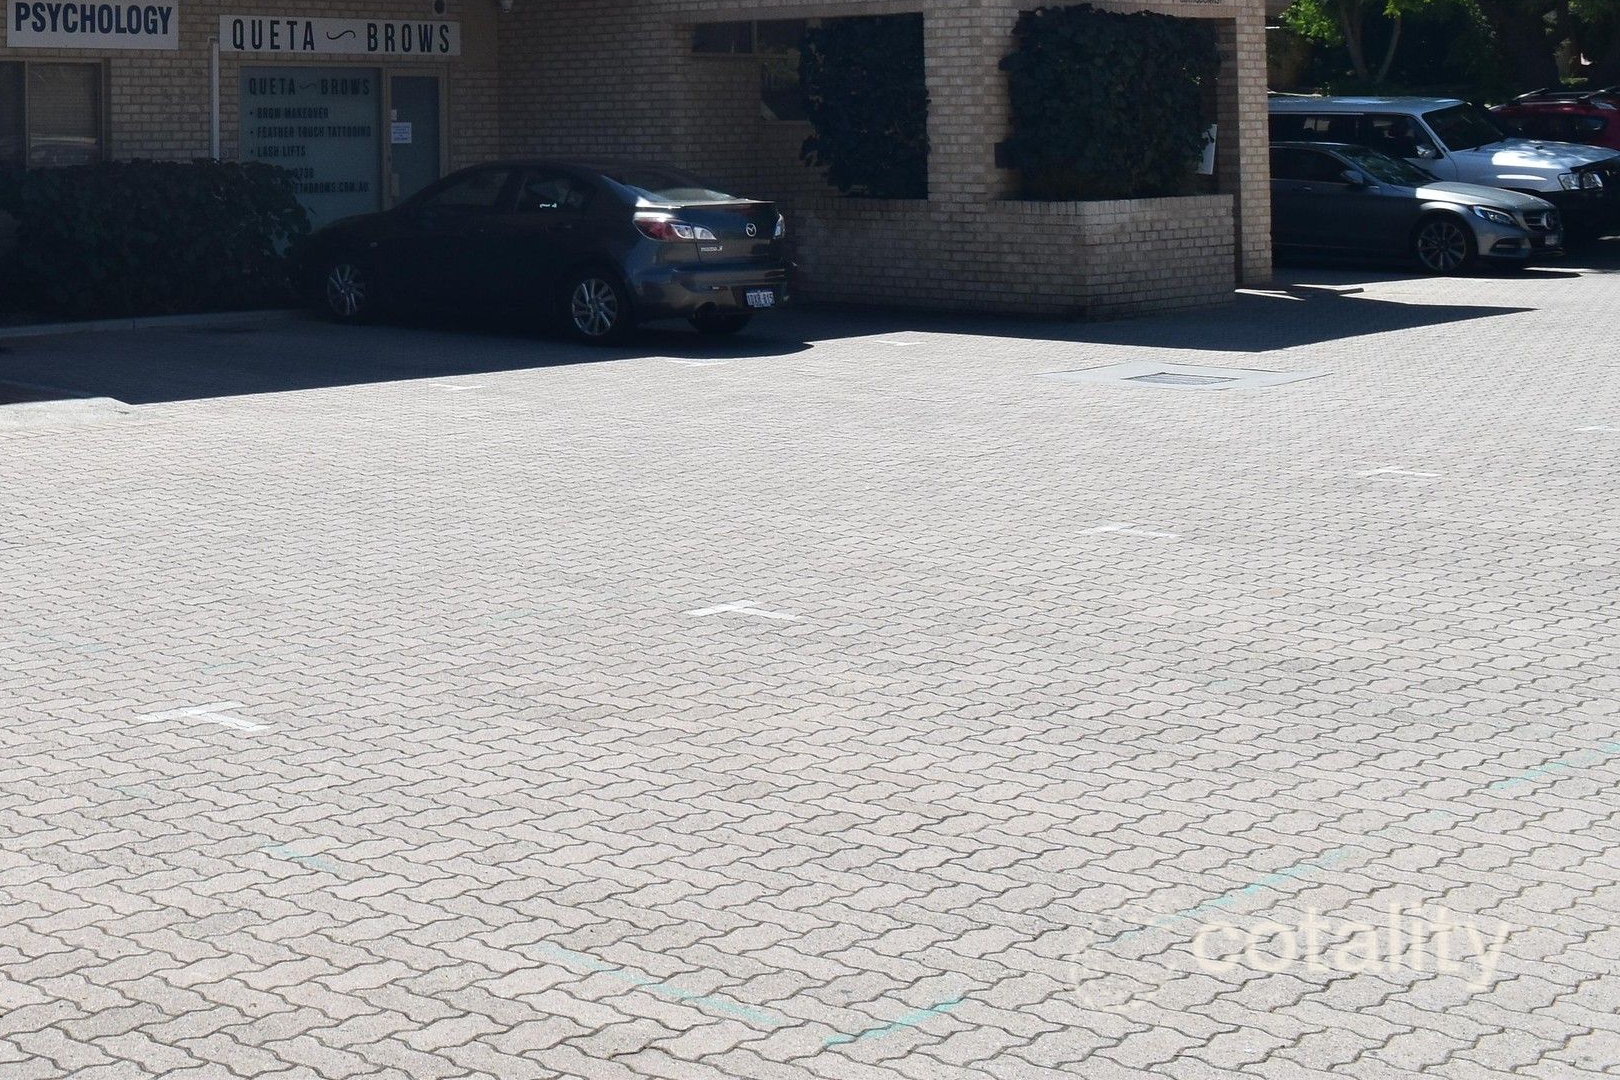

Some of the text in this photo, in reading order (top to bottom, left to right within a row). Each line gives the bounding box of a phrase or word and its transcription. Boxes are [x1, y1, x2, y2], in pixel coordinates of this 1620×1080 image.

[14, 1, 173, 36] PSYCHOLOGY
[232, 19, 450, 54] QUETA BROWS
[248, 78, 370, 96] QUETA BROWS
[257, 107, 329, 119] BROW MAKEOVER
[257, 126, 371, 138] FEATHER TOUCH TATTOOING
[257, 145, 306, 157] LASH LIFTS
